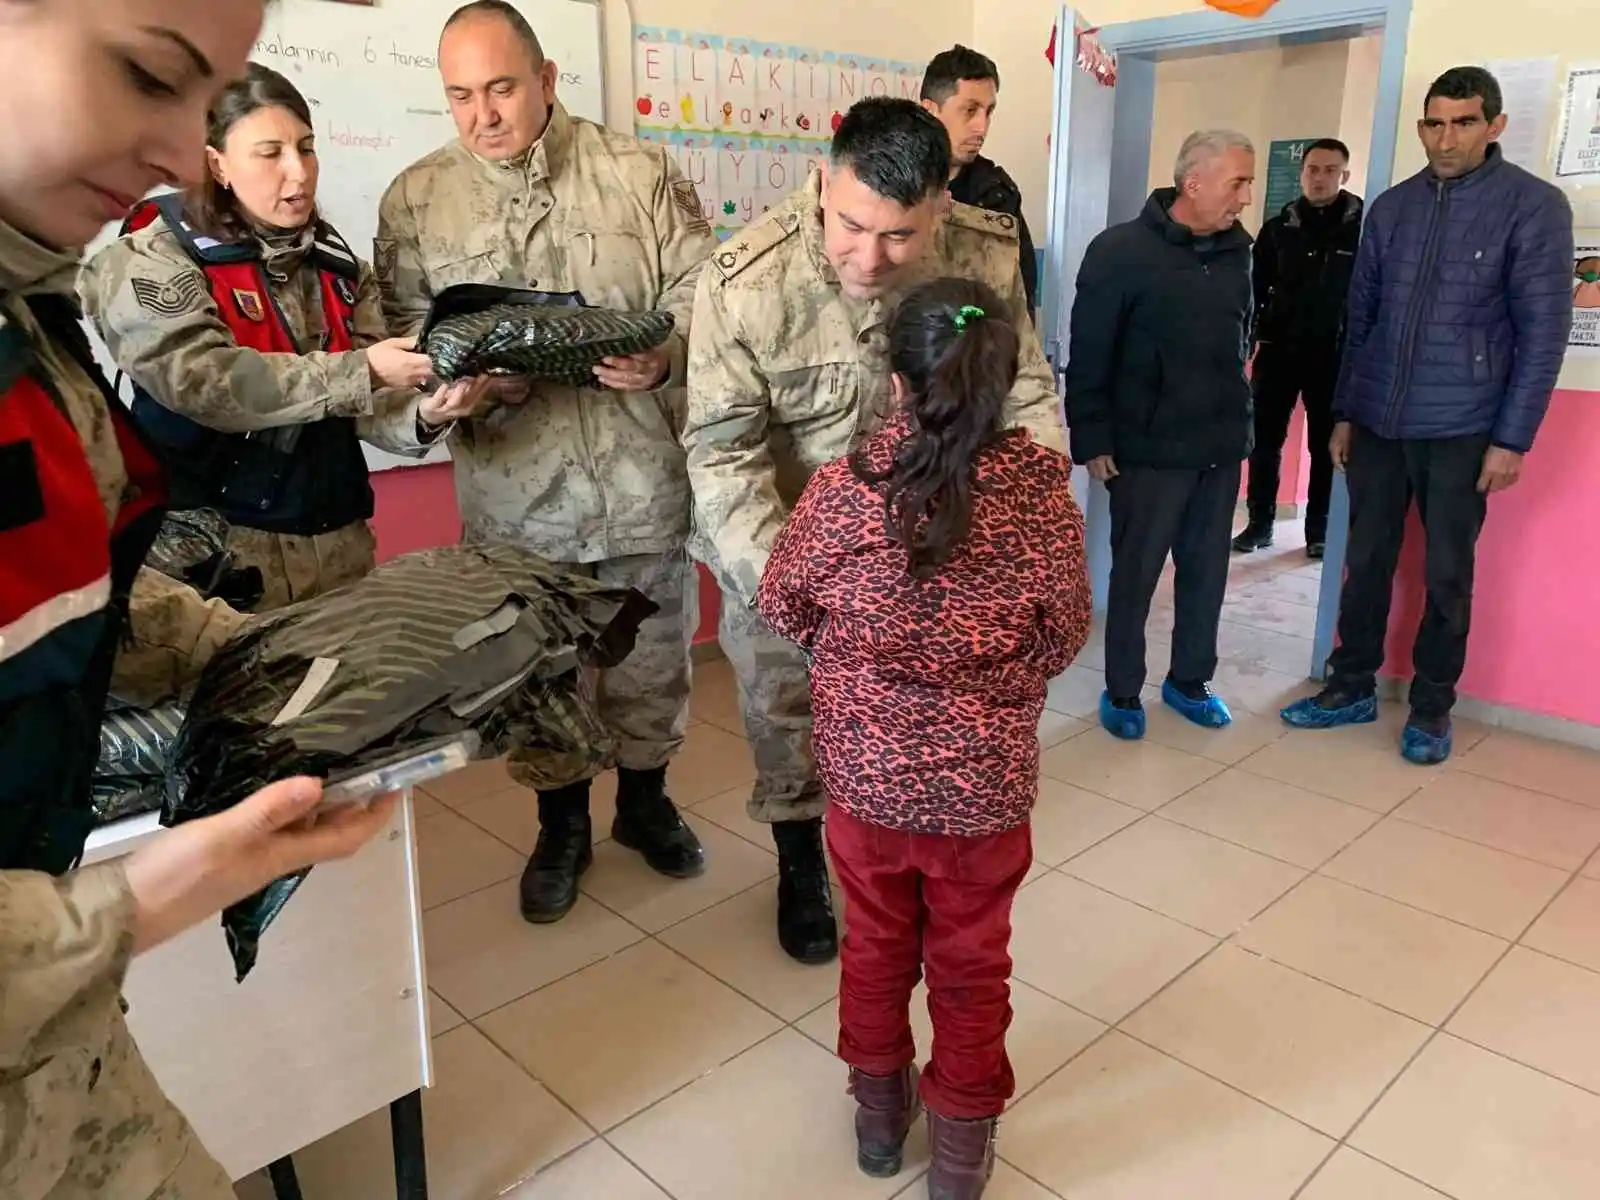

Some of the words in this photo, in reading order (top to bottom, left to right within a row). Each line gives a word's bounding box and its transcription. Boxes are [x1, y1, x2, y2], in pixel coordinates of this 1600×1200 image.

[363, 35, 377, 64] 6
[646, 48, 661, 80] E
[692, 52, 705, 81] L
[729, 57, 745, 85] A
[770, 63, 782, 92] K
[840, 71, 855, 98] N
[658, 101, 670, 118] e
[740, 107, 752, 124] a
[781, 103, 789, 129] k
[730, 153, 745, 183] Y
[768, 157, 785, 189] Ö
[740, 196, 753, 223] y
